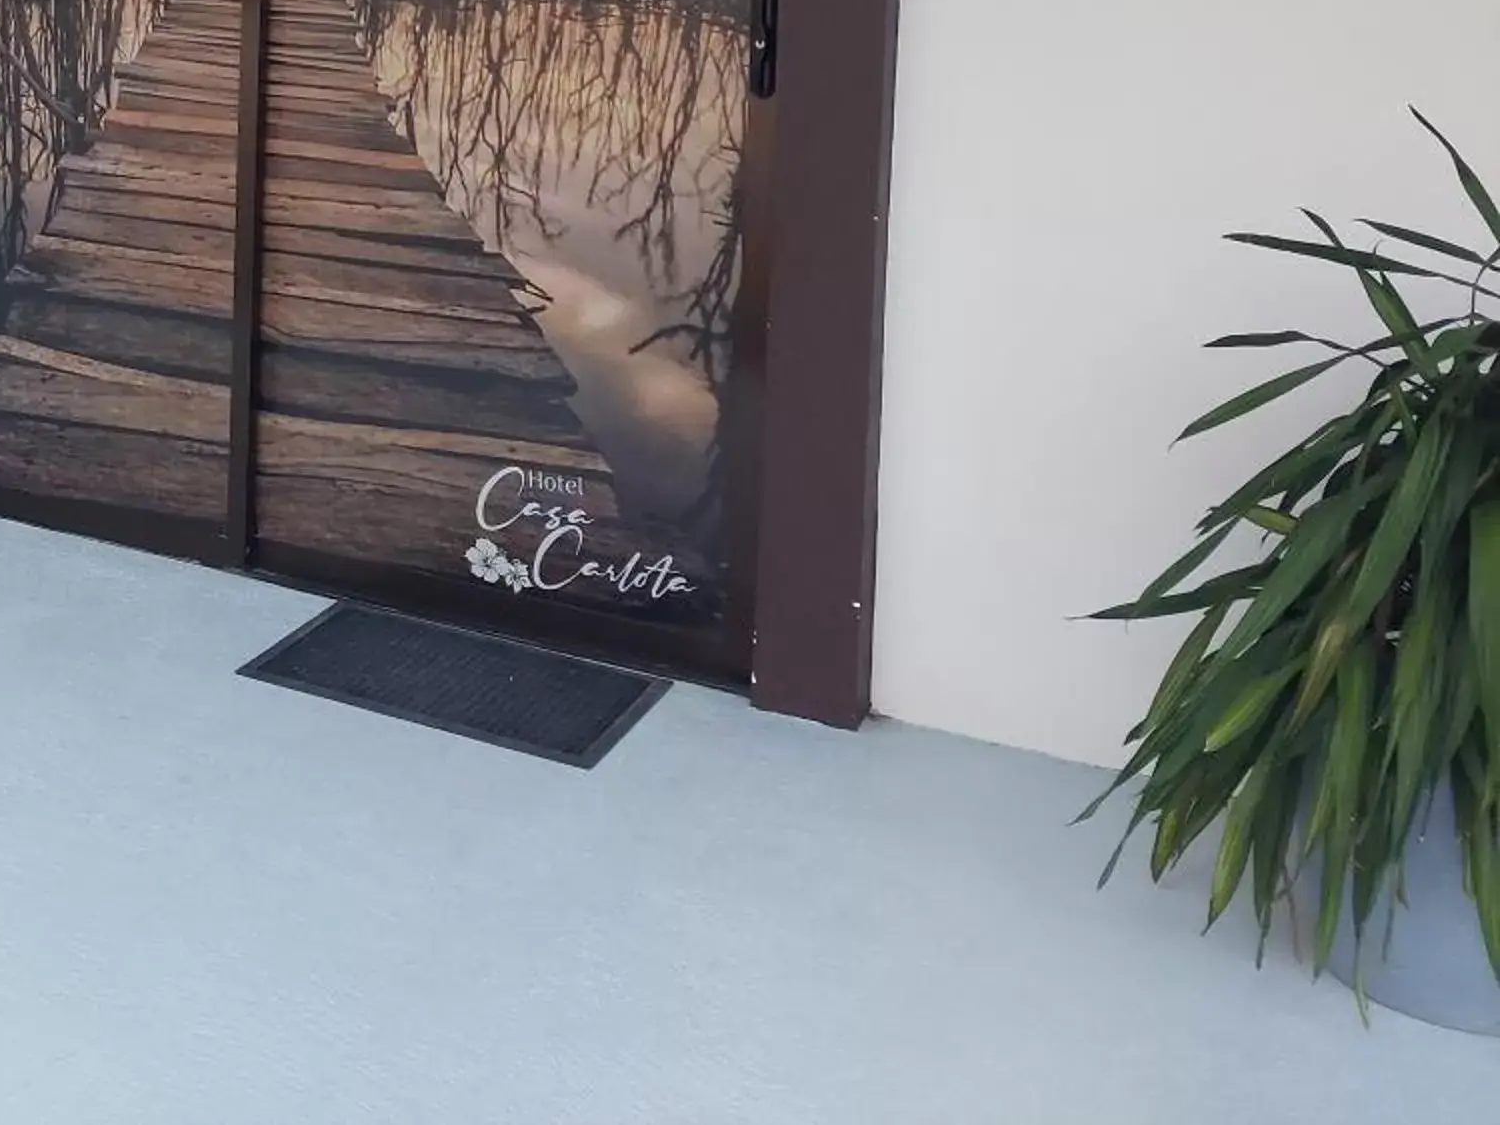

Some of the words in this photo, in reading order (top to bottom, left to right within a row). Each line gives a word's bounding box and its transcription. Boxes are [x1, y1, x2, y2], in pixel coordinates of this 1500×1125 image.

[475, 465, 595, 531] Casa
[528, 469, 584, 496] Hotel
[533, 524, 699, 599] Carlota
